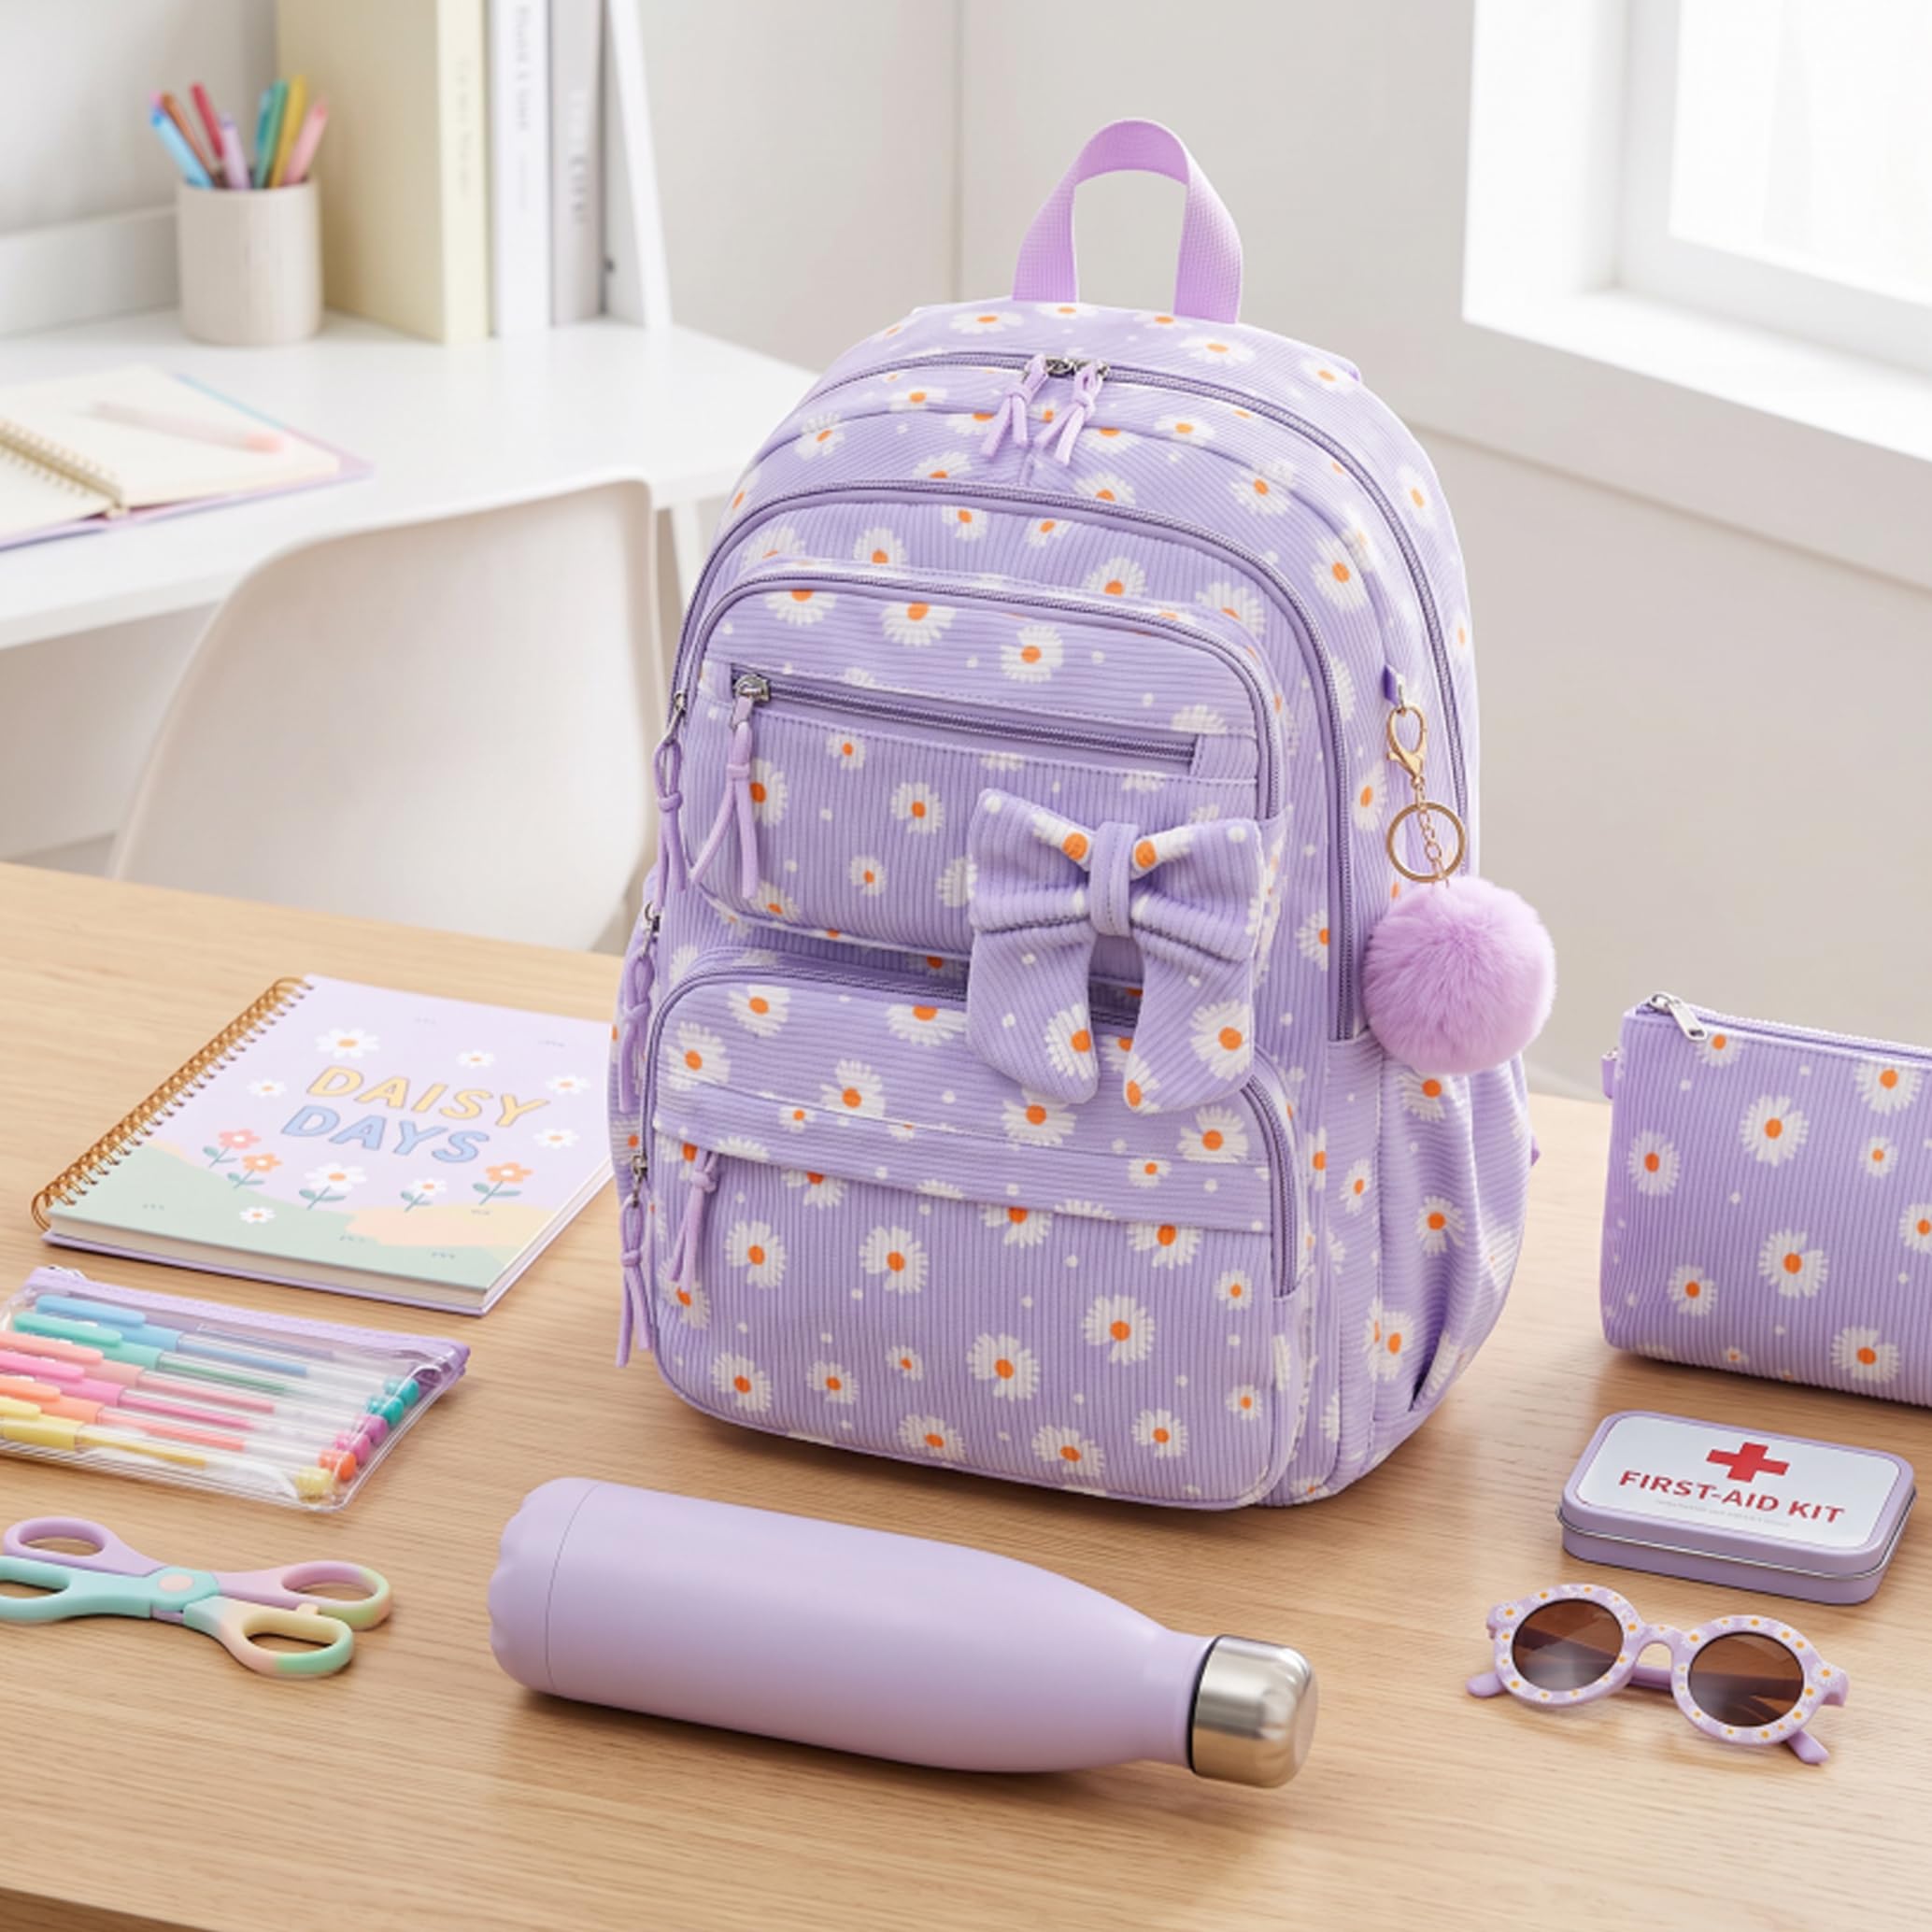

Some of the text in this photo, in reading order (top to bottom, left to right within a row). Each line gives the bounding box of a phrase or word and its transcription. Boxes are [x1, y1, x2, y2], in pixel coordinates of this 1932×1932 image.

[305, 1066, 551, 1128] DAISY
[280, 1105, 491, 1164] DAYS
[1618, 1470, 1780, 1513] FIRST-AID
[1787, 1500, 1845, 1524] KIT
